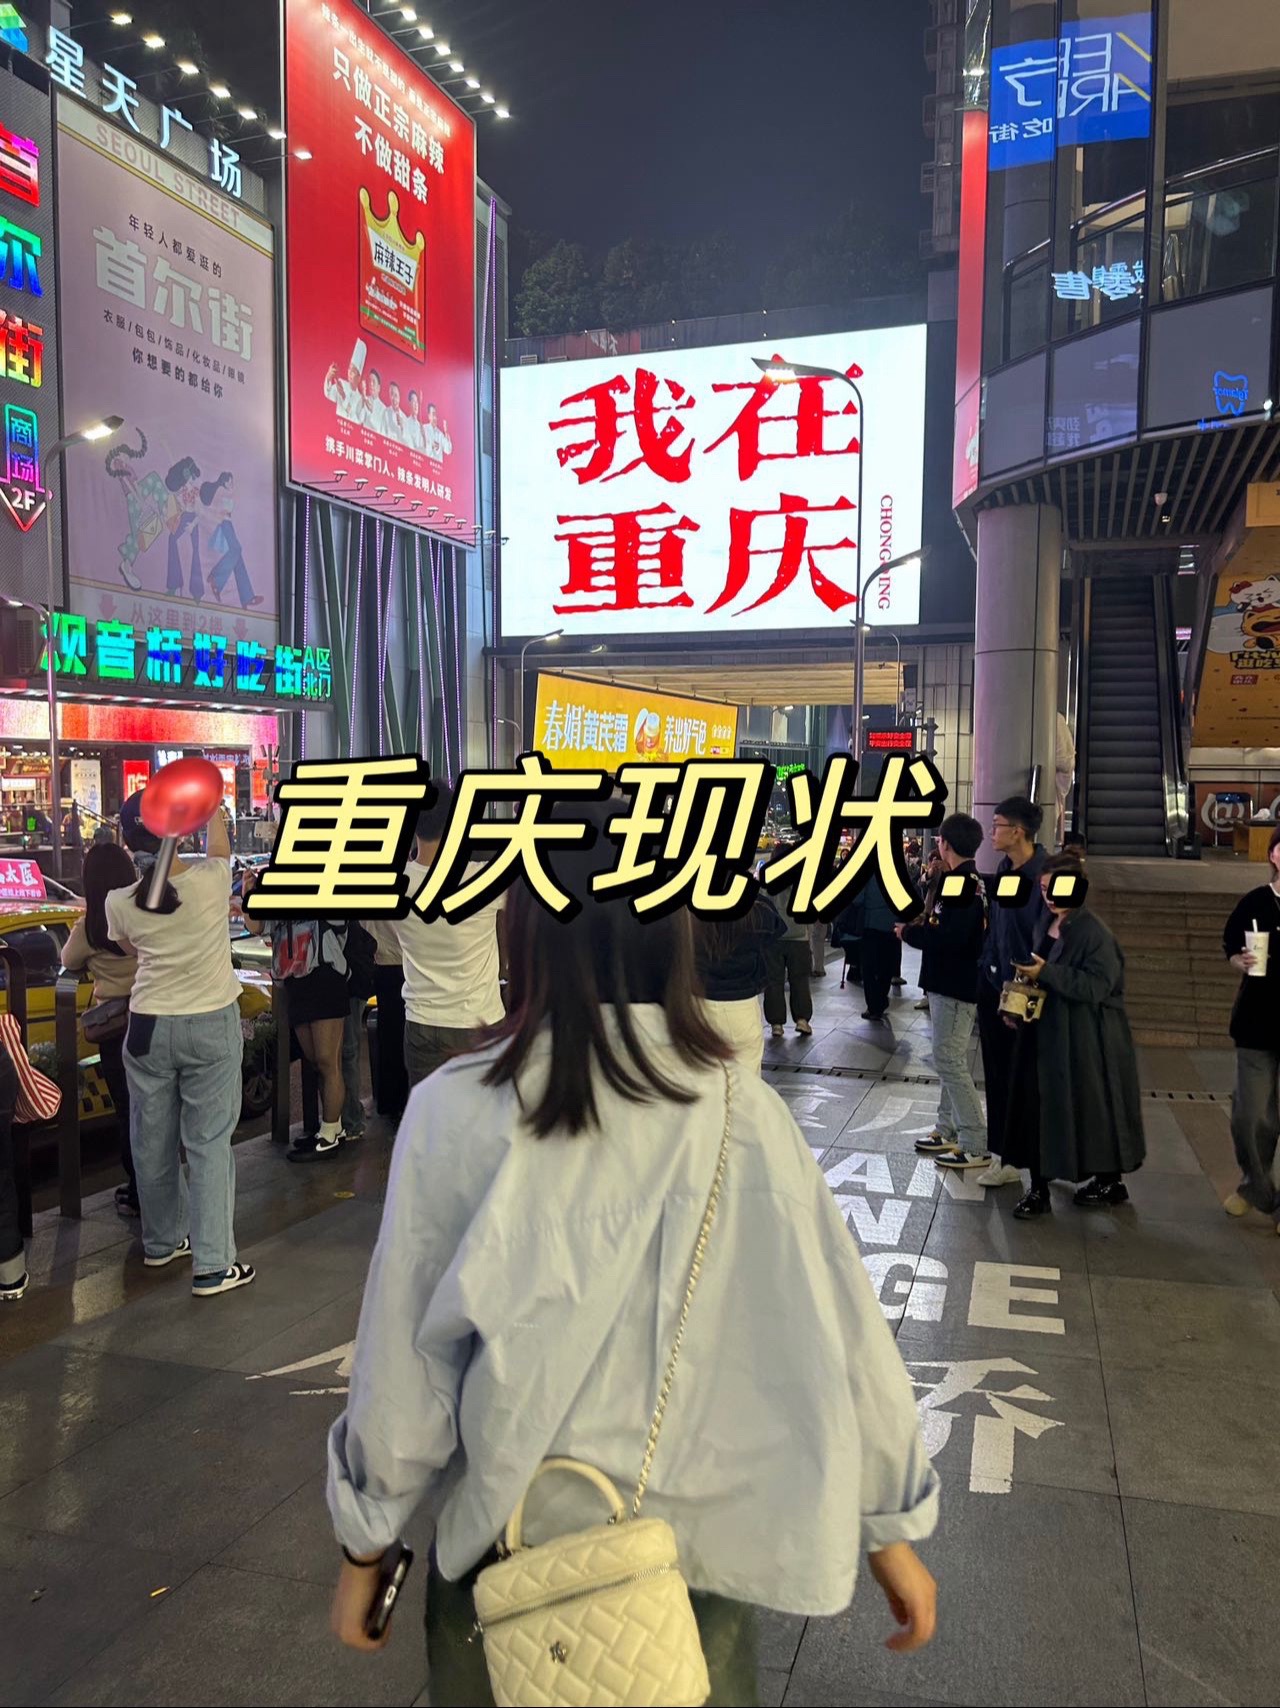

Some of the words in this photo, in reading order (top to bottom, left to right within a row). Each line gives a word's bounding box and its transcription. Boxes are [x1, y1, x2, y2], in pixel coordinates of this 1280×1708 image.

[46, 25, 243, 199] 星天广场
[332, 47, 445, 175] 只做正宗麻辣
[96, 122, 165, 185] SEOUL
[173, 172, 240, 229] STREET
[354, 115, 428, 205] 不做甜条
[128, 213, 222, 279] 年轻人都爱逛的
[373, 241, 414, 285] 麻辣王子
[93, 225, 253, 363] 首尔街
[103, 309, 246, 385] 衣服/包包/饰品/化妆品/眼镜
[132, 346, 224, 399] 你想要的都给你
[10, 416, 34, 484] 商场
[548, 353, 865, 485] 我在
[12, 487, 36, 511] 2F
[552, 492, 860, 617] 重庆
[40, 612, 303, 696] 观音桥好吃街
[303, 646, 331, 672] A区
[303, 671, 332, 698] 北门
[663, 714, 707, 756] 养出好气色
